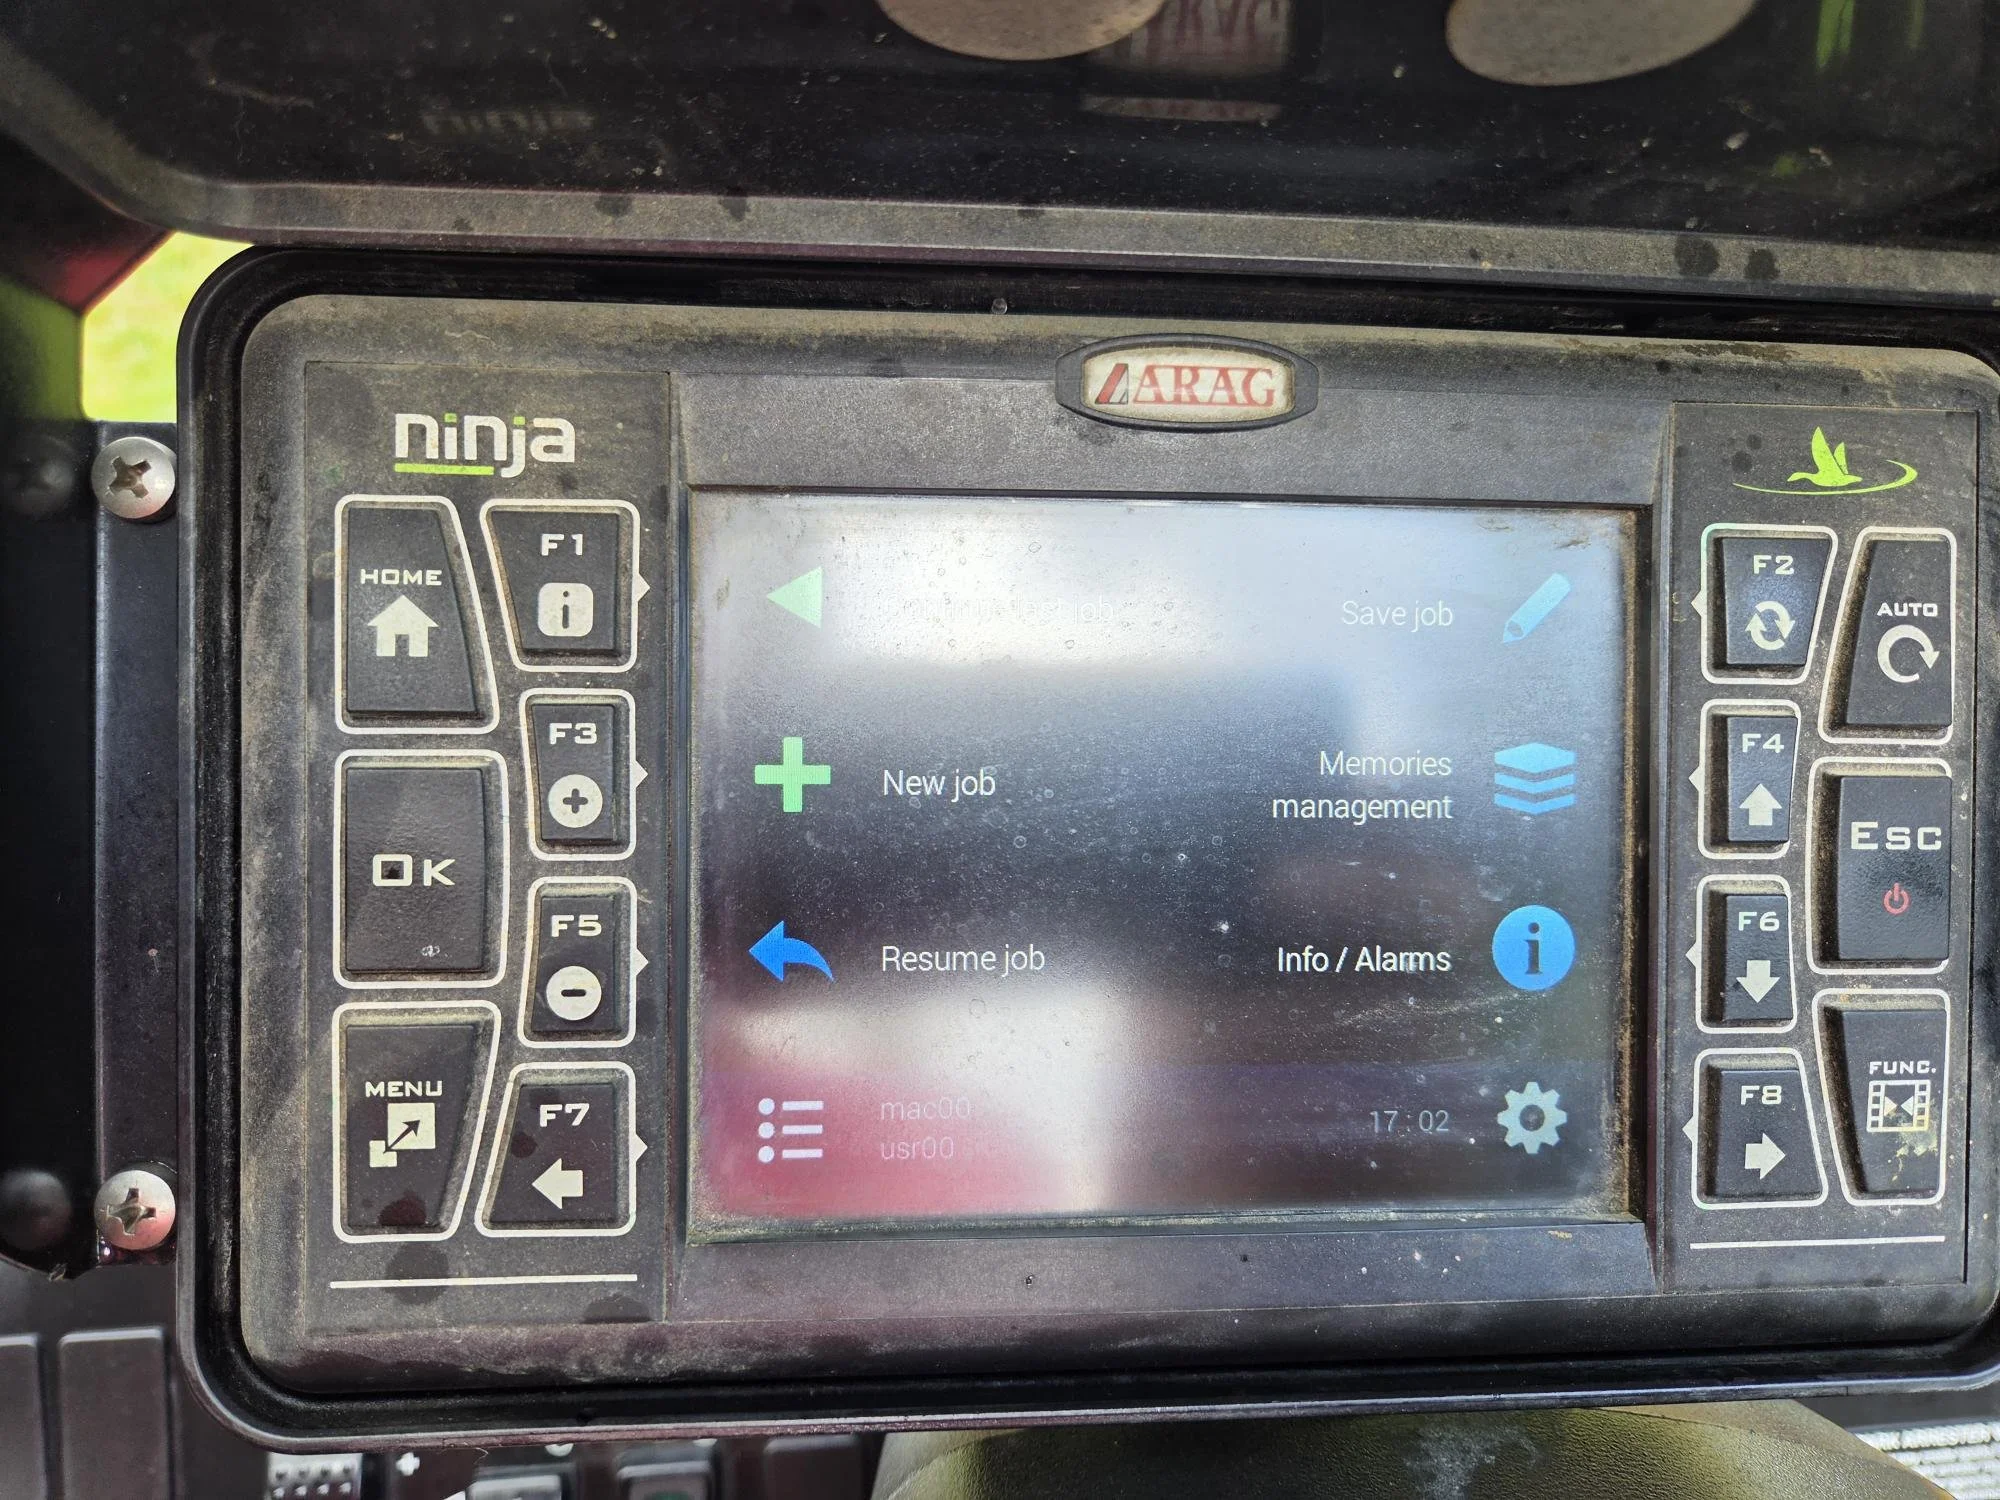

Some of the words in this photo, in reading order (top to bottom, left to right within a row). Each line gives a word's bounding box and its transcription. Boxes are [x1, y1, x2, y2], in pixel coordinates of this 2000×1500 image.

[1132, 364, 1275, 407] ARAG
[394, 412, 576, 478] ninja
[540, 533, 585, 556] F1
[360, 568, 443, 586] HOME
[1752, 555, 1795, 575] F2
[1072, 593, 1114, 625] job
[1341, 600, 1406, 626] Save
[1411, 600, 1454, 633] job
[1876, 602, 1938, 617] AUTO
[549, 722, 598, 745] F3
[1741, 733, 1785, 754] F4
[1319, 750, 1452, 777] Memories
[883, 769, 945, 796] New
[951, 769, 996, 803] job
[1271, 797, 1453, 826] management
[372, 853, 456, 887] OK
[550, 914, 602, 938] F5
[1737, 911, 1780, 932] F6
[881, 945, 997, 972] Resume
[1001, 944, 1046, 978] job
[1277, 945, 1330, 973] Info
[1334, 946, 1349, 973] /
[1354, 945, 1453, 973] Alarms
[1869, 1060, 1937, 1075] FUNC.
[364, 1080, 443, 1098] MENU
[1740, 1085, 1783, 1106] F8
[539, 1102, 590, 1127] F7
[880, 1096, 971, 1121] mac00
[880, 1136, 955, 1160] usr00
